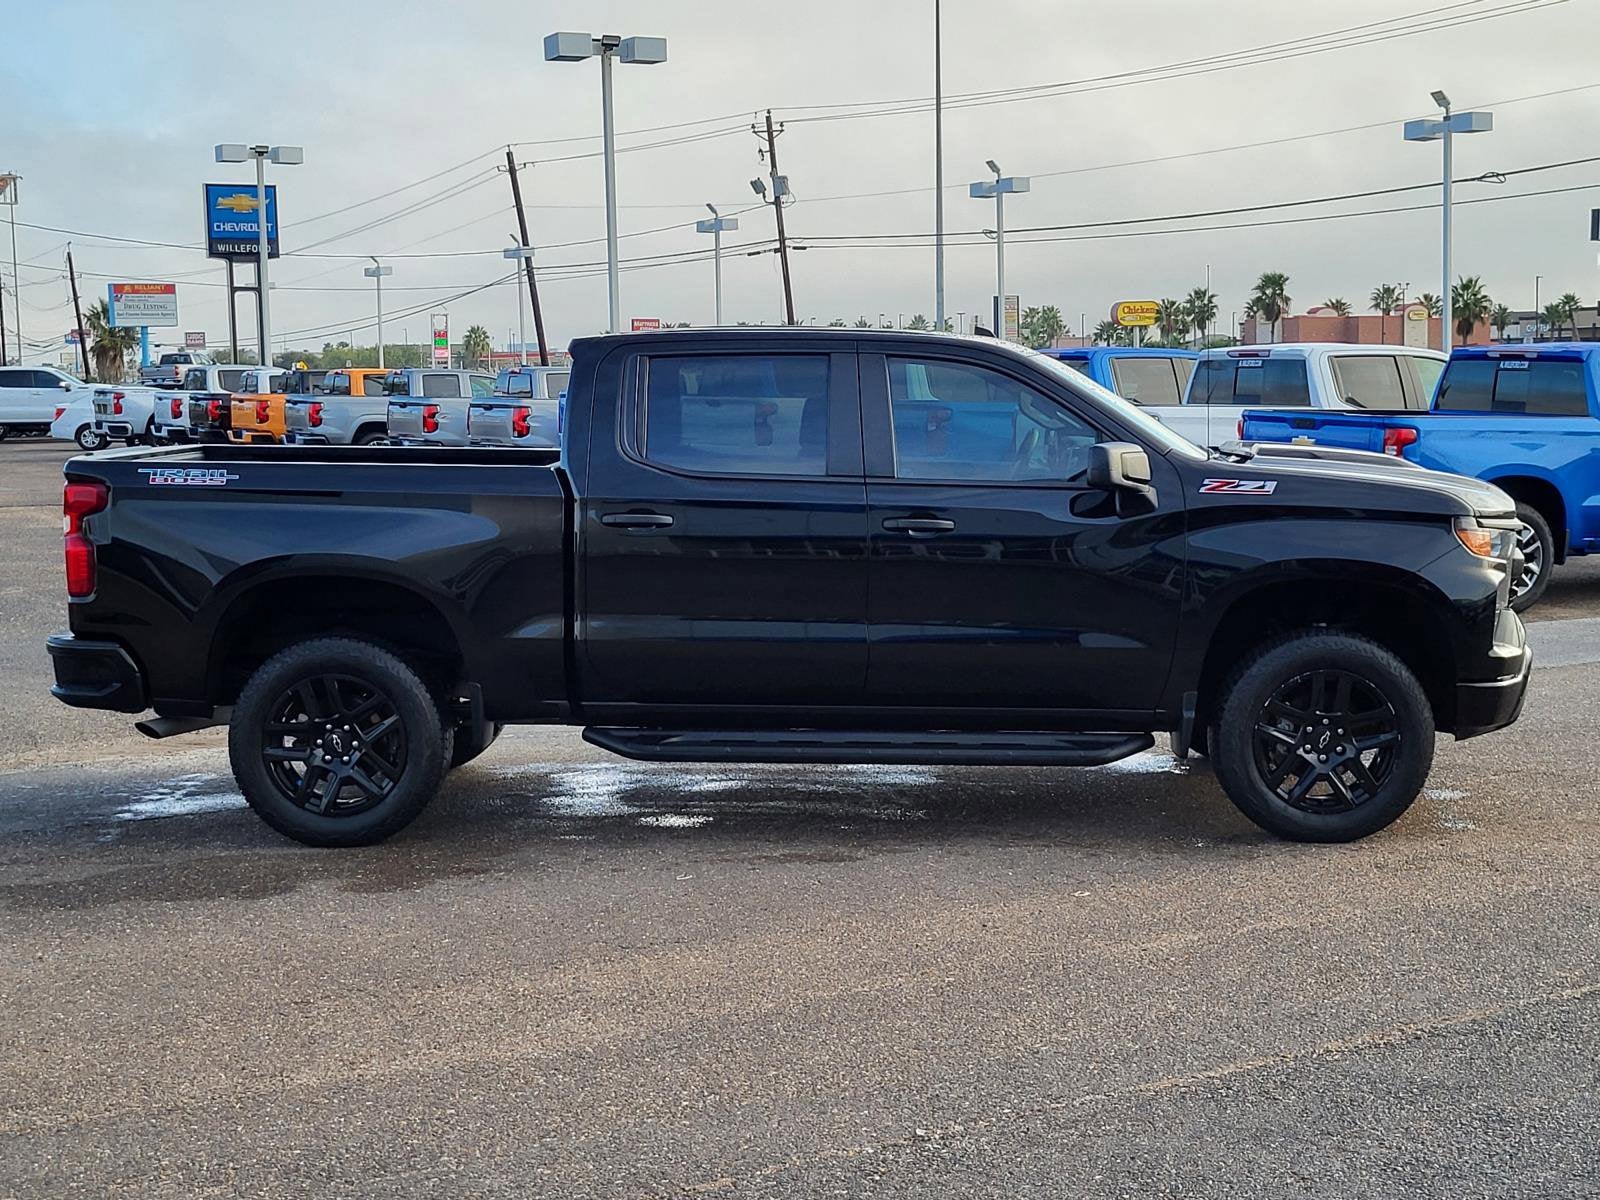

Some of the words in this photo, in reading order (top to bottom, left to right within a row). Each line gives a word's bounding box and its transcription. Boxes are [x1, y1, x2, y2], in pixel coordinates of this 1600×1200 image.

[213, 222, 273, 232] CHEVROLT
[217, 244, 271, 253] WILLEFOD
[1122, 305, 1155, 315] Chicken
[1198, 478, 1278, 495] Z71
